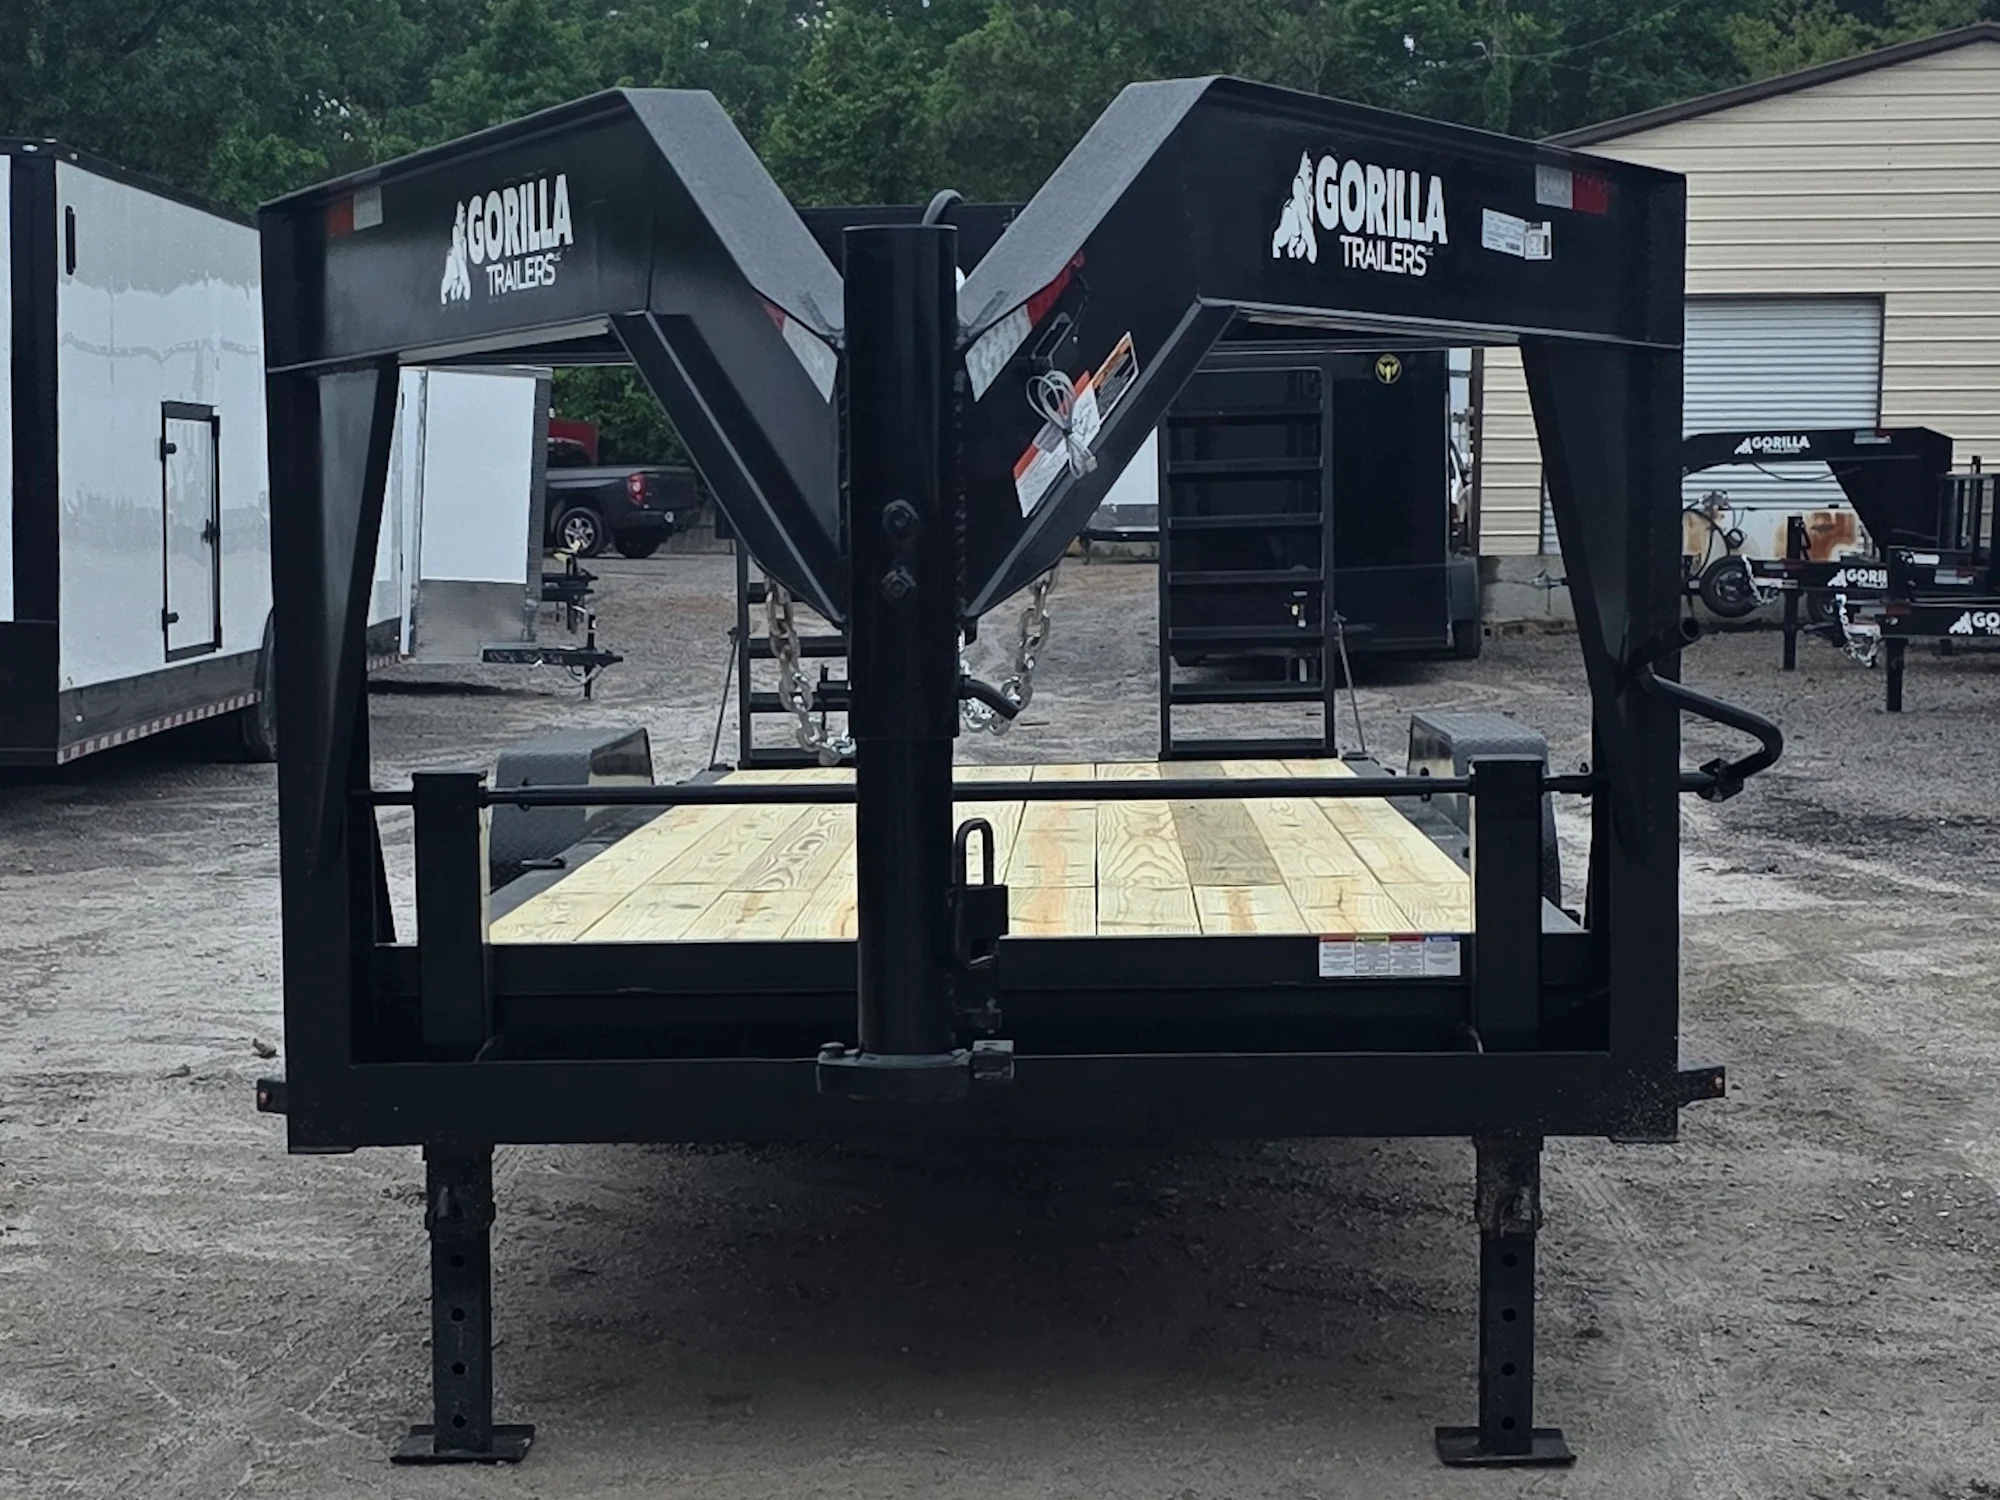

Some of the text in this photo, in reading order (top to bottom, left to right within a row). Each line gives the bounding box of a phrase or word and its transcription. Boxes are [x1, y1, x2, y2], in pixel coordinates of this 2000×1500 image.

[467, 173, 574, 264] GORILLA
[1315, 154, 1448, 244] GORILLA
[486, 252, 556, 296] TRAILERS
[1340, 235, 1428, 276] TRAILERS
[1751, 435, 1811, 449] GORILLA
